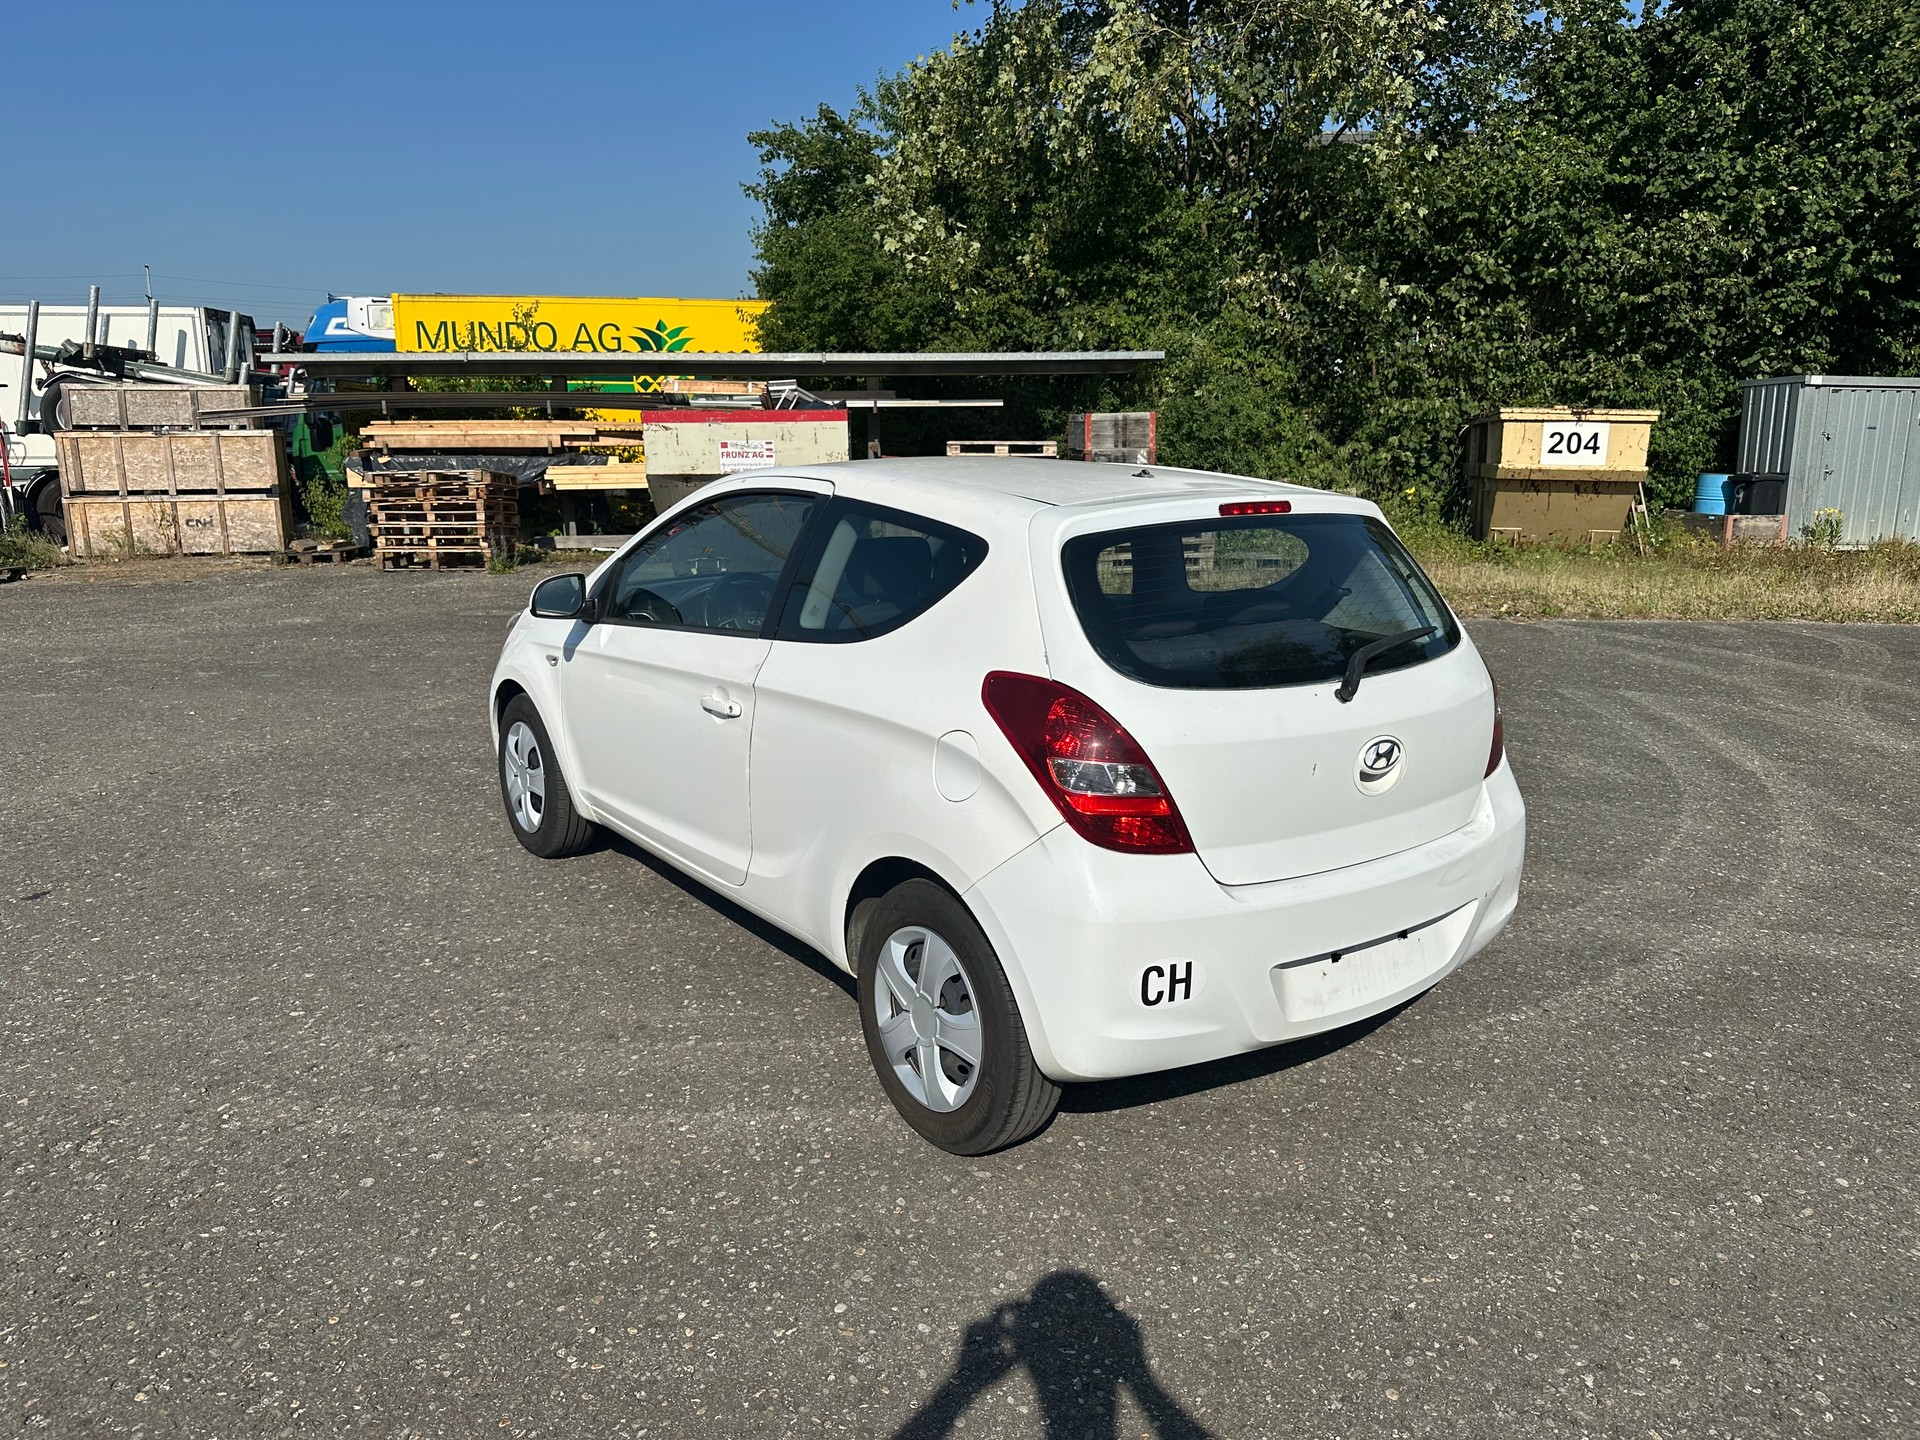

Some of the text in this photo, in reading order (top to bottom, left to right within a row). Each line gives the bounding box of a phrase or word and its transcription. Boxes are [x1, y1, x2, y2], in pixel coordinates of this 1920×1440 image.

[416, 320, 622, 351] MUNDO AG
[1547, 432, 1600, 454] 204
[1141, 961, 1192, 1006] CH
